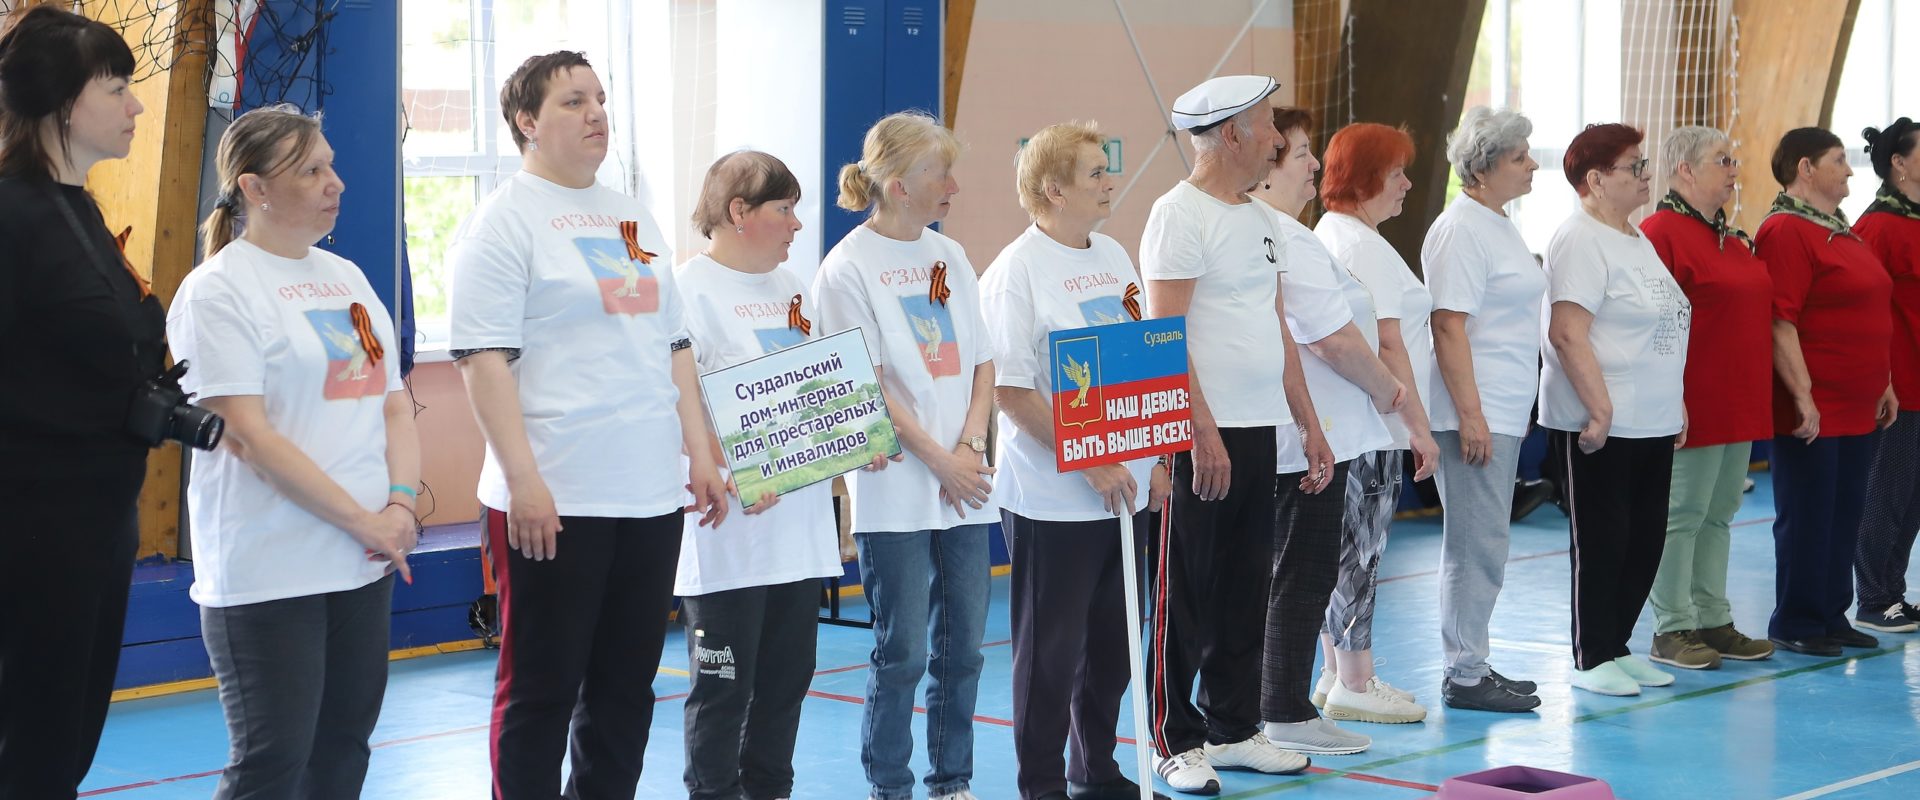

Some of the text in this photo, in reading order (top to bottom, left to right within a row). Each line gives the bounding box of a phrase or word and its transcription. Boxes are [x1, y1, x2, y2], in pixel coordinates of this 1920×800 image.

[551, 213, 620, 231] СУЗДАЛ
[1063, 272, 1119, 293] СУЗДАЛЬ
[1144, 329, 1184, 347] Суздаль
[735, 352, 843, 401] Суздальский
[740, 380, 855, 430] дом-интернат
[1105, 388, 1190, 421] НАШ ДЕВИЗ:
[734, 400, 878, 461] для престарелых
[1062, 419, 1192, 462] БЫТЬ ВЫШЕ ВСЕХ!
[761, 431, 868, 478] и инвалидов
